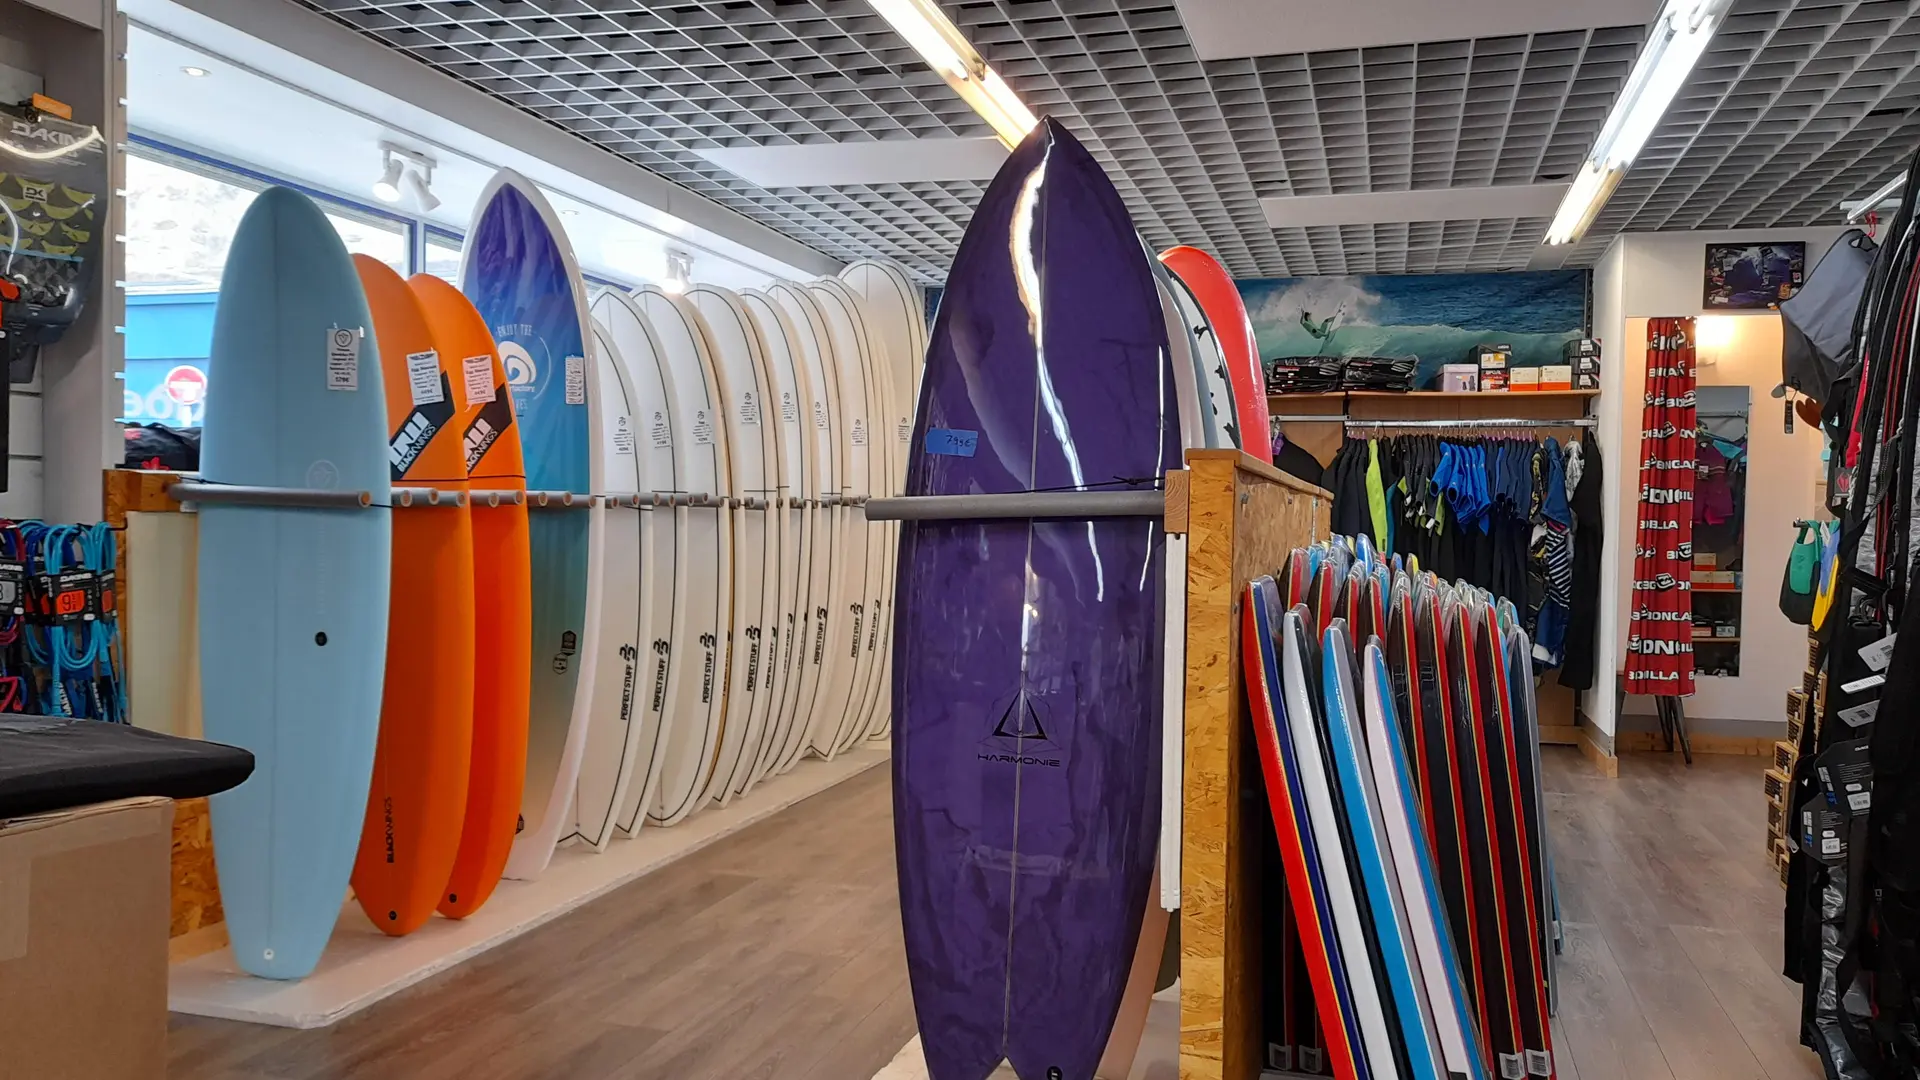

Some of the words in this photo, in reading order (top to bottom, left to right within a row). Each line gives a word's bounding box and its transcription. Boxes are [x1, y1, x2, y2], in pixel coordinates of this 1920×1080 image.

[397, 423, 437, 473] BLACKWINGS
[465, 428, 498, 471] LACKWINGS
[705, 651, 713, 673] STUFF
[750, 643, 758, 663] STUFF
[624, 664, 633, 688] STUFF
[652, 681, 662, 712] PERFECT
[657, 658, 666, 682] STUFF
[702, 673, 711, 703] PERFECT
[747, 662, 756, 692] PERFECT
[620, 688, 630, 720] PERFECT
[977, 753, 1060, 768] HARMONIE
